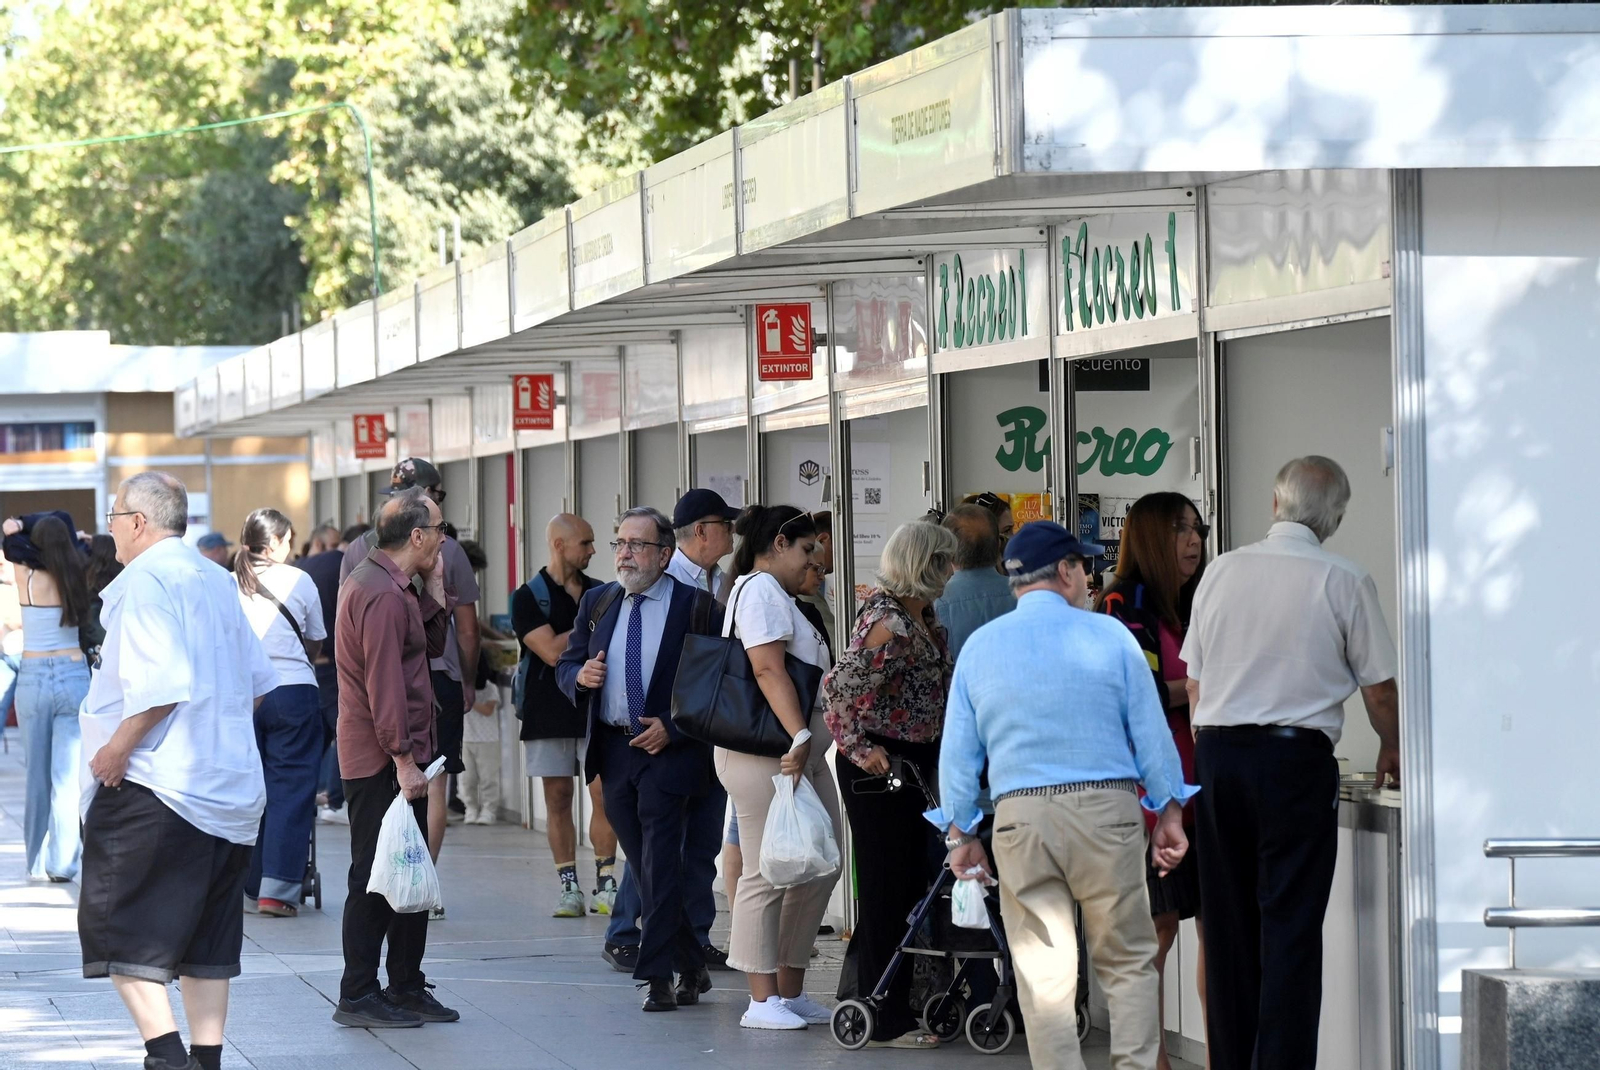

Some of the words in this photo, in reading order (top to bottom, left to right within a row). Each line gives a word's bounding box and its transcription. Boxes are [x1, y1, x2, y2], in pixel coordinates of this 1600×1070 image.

[762, 363, 808, 373] EXTINTOR
[995, 406, 1174, 477] Rcreo
[1024, 500, 1038, 510] LUZ
